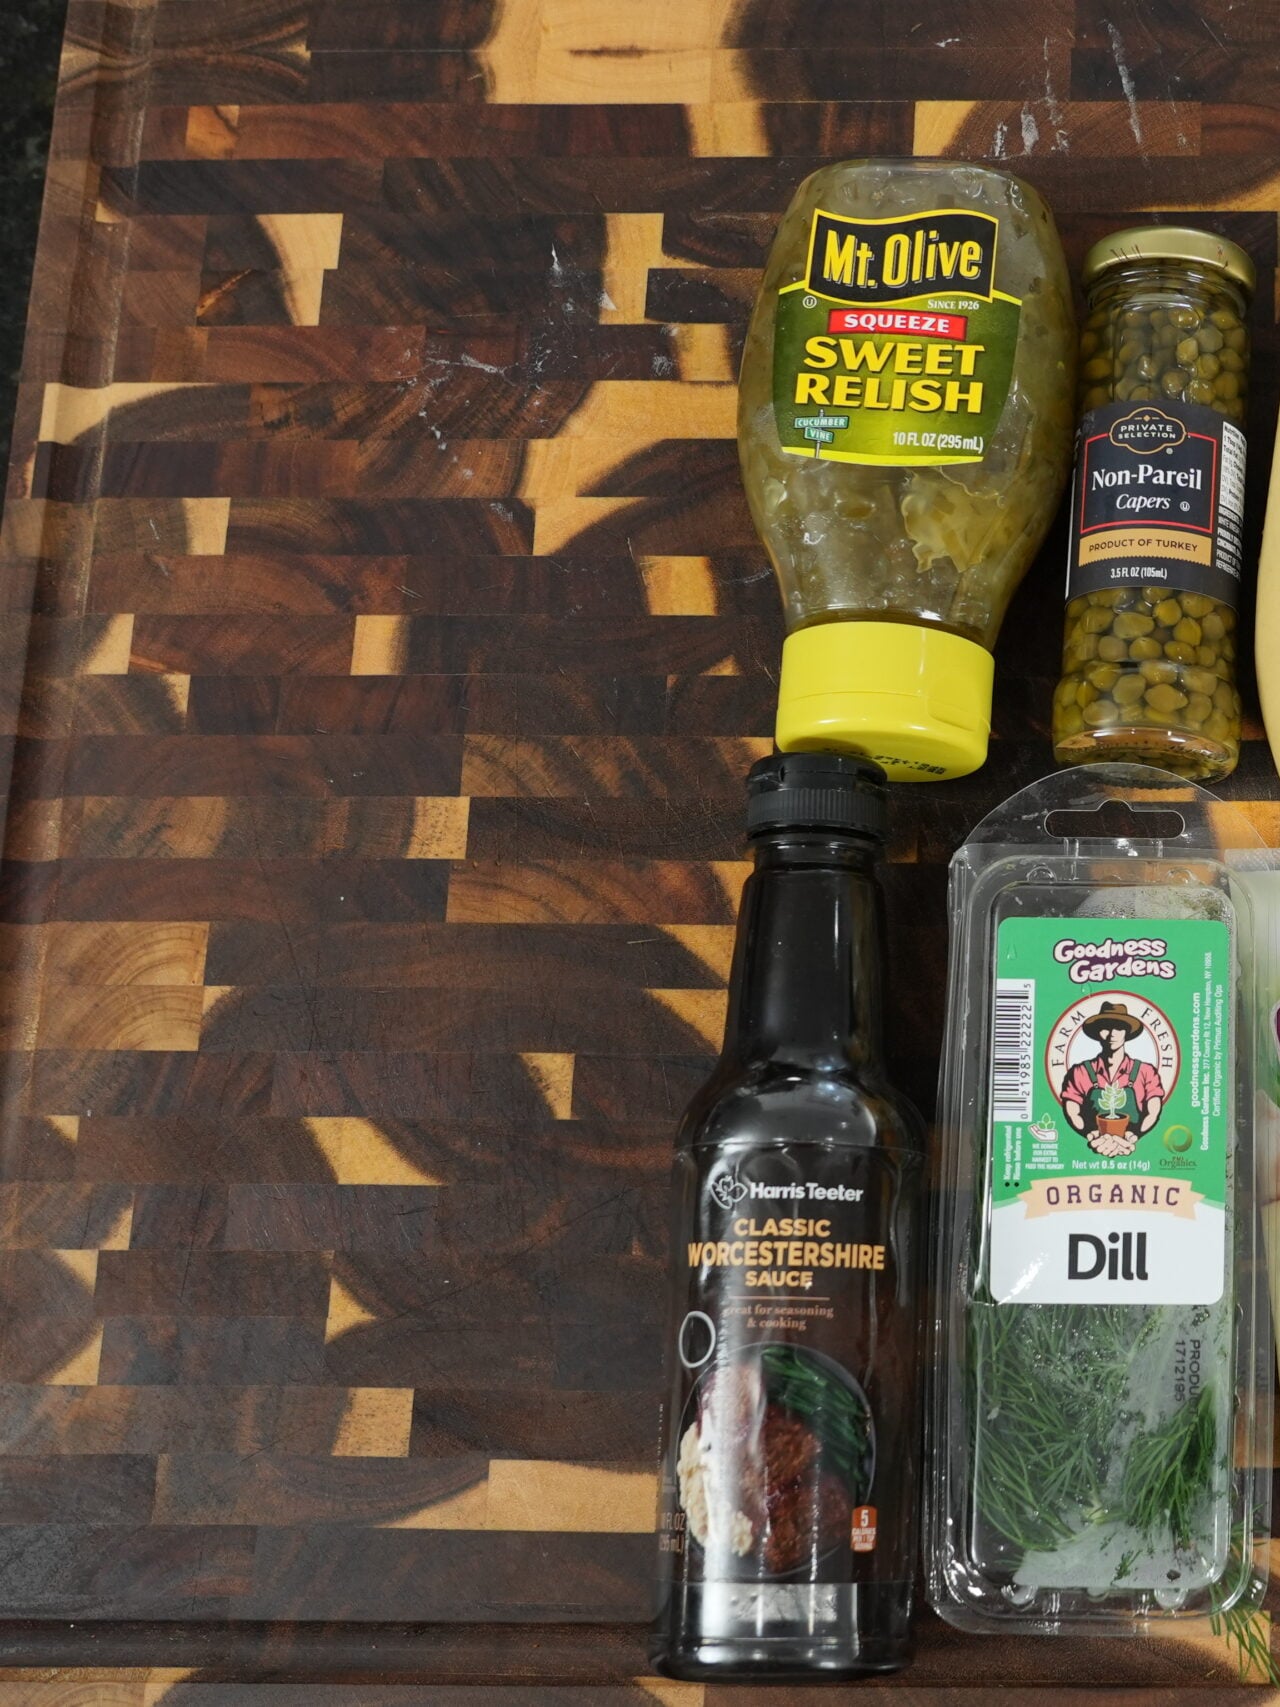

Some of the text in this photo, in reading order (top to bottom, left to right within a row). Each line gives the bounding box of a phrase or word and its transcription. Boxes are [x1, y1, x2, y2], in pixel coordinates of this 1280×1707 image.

[823, 229, 982, 287] Mt. Olive
[927, 300, 979, 311] SINCE 1926
[844, 314, 950, 333] SQUEEZE
[804, 336, 985, 376] SWEET
[795, 373, 983, 413] RELISH
[798, 418, 845, 427] CUCUMBER
[1120, 424, 1173, 432] PRIVATE
[810, 430, 831, 441] VINE
[893, 432, 906, 444] 10
[907, 433, 921, 445] FL
[922, 434, 936, 446] OZ
[1092, 464, 1202, 491] Non-Pareil
[1116, 493, 1171, 512] Capers
[1089, 539, 1134, 552] PRODUCT
[1155, 539, 1198, 552] TURKEY
[1111, 568, 1121, 578] 3.5
[1122, 567, 1129, 577] FL
[1131, 567, 1140, 578] OZ
[1054, 939, 1167, 962] Goodness
[1069, 959, 1176, 983] Gardens
[1204, 970, 1212, 979] NY
[1021, 1005, 1031, 1046] 22222
[1052, 1009, 1086, 1068] FARM
[1141, 1007, 1173, 1069] FRESH
[1190, 992, 1202, 1108] goodnessgardens.com
[1212, 985, 1223, 1117] Certified Organic by Primus Auditing Ops
[1021, 1054, 1030, 1096] 21985
[1201, 1086, 1210, 1115] Gardens
[1003, 1163, 1012, 1180] Keep
[1072, 1159, 1150, 1171] Net wt 0.5 oz (14g)
[750, 1182, 864, 1202] Harris Teeter
[1046, 1184, 1181, 1207] ORGANIC
[734, 1218, 831, 1237] CLASSIC
[688, 1241, 886, 1270] WORCESTERSHIRE
[1067, 1232, 1149, 1281] Dill
[745, 1271, 813, 1287] SAUCE
[755, 1304, 773, 1315] for
[775, 1305, 834, 1317] seasoning
[747, 1317, 807, 1331] & cooking
[673, 1512, 686, 1531] OZ
[860, 1509, 869, 1527] 5
